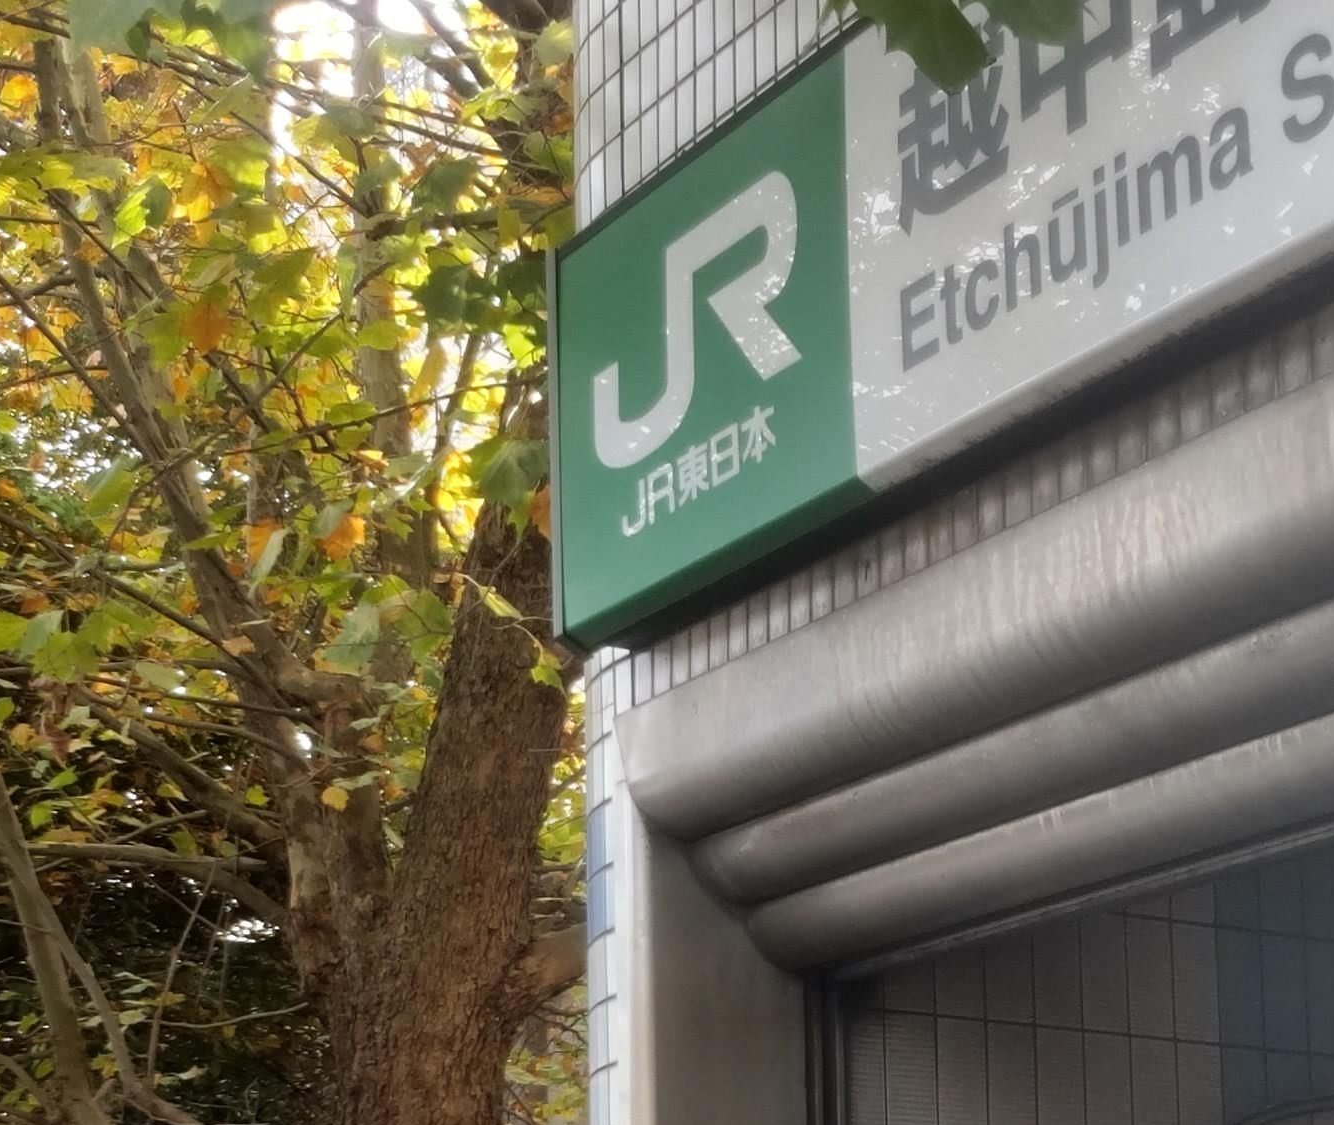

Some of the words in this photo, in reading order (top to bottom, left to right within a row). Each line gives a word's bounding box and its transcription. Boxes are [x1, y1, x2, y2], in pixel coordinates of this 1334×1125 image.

[592, 170, 803, 470] JR
[902, 106, 1255, 372] Etchūjima
[621, 404, 777, 538] JR東日本
